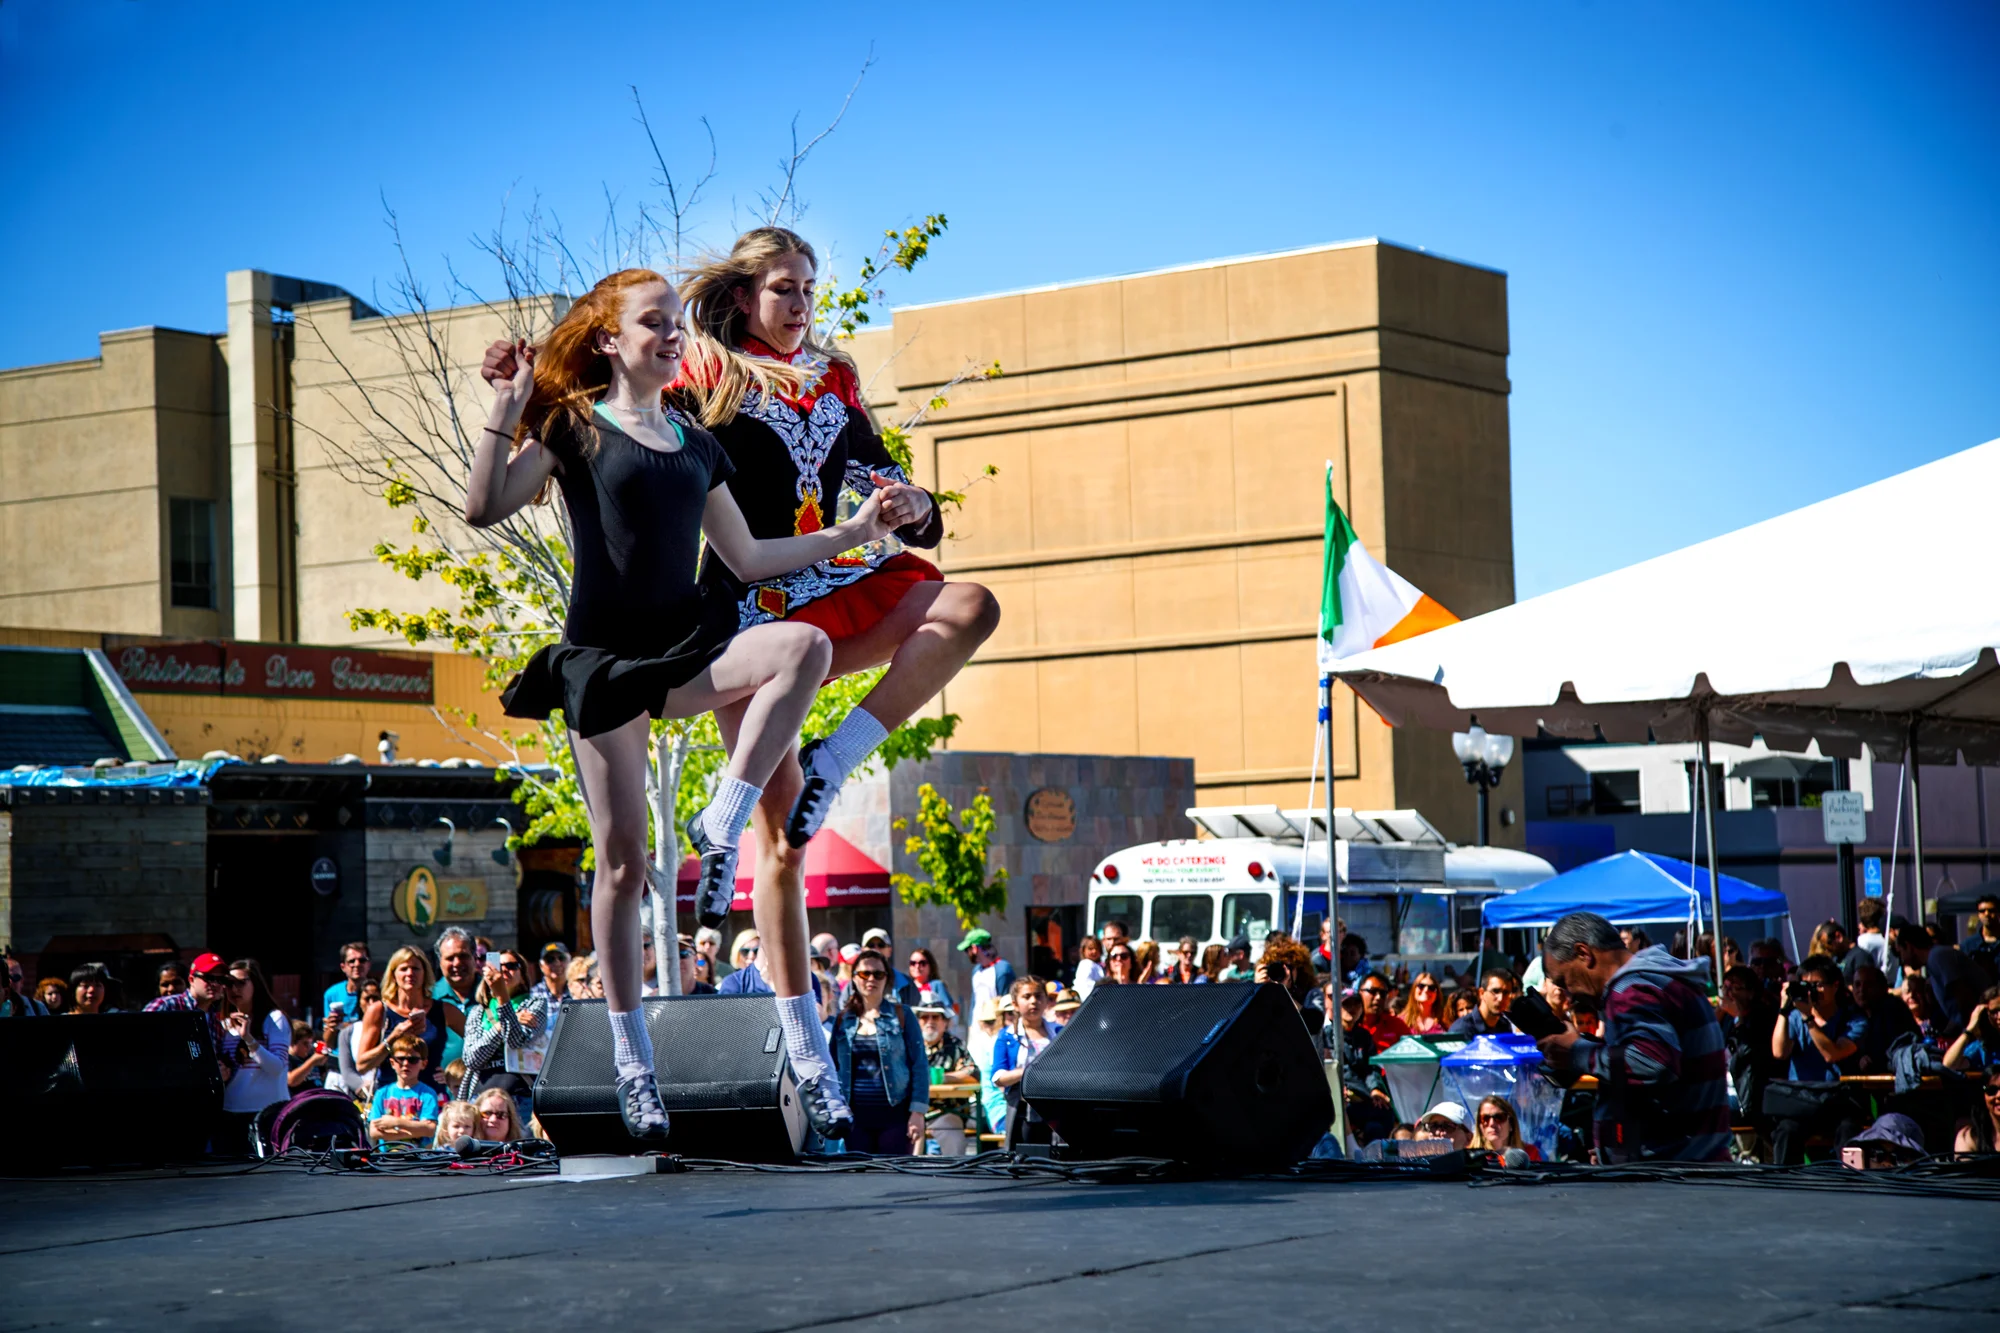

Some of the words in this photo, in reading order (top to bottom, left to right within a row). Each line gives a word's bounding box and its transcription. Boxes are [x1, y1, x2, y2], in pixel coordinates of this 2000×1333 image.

[120, 646, 246, 685] Ristorante
[265, 653, 316, 689] Don
[330, 656, 433, 693] Giovanni
[1829, 804, 1860, 815] Parking
[1142, 857, 1154, 866] WE
[1157, 857, 1171, 866] DO
